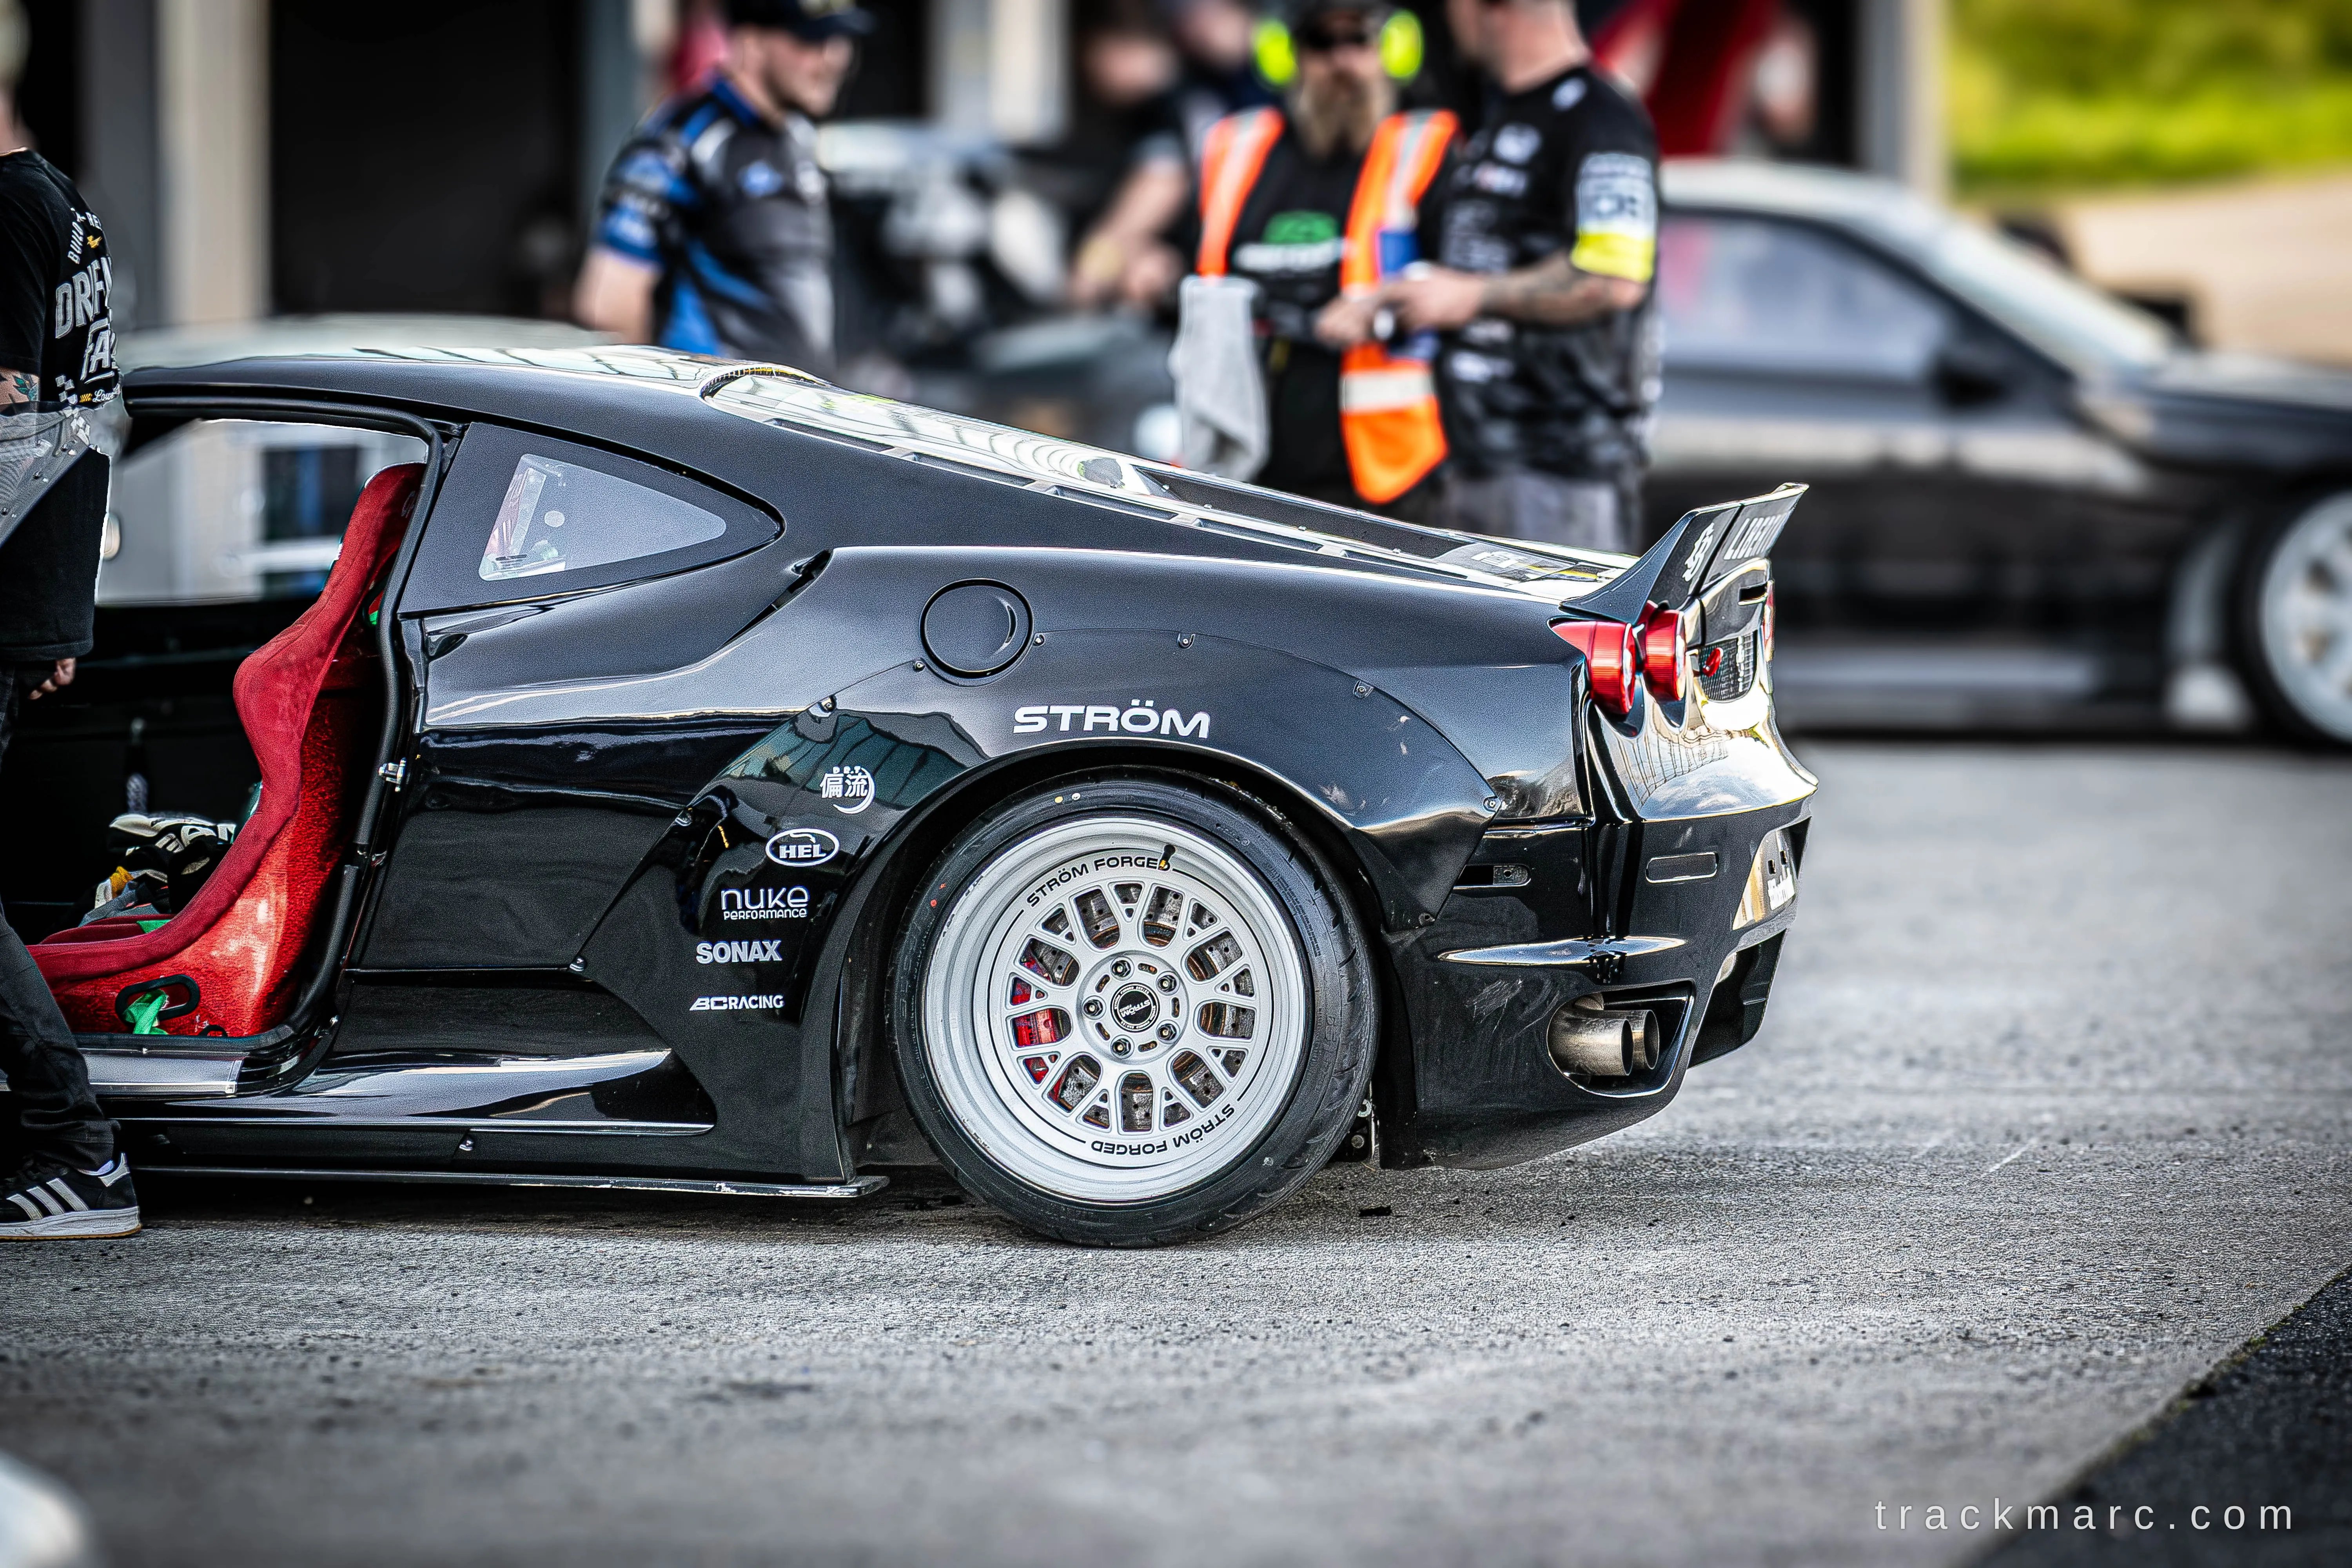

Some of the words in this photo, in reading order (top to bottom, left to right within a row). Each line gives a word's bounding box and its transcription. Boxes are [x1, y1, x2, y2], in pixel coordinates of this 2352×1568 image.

[1013, 699, 1210, 739] STRÖM
[820, 772, 867, 798] 偏流
[779, 843, 827, 858] HEL
[1027, 864, 1089, 907] STRÖM
[696, 940, 783, 964] SONAX
[1121, 1000, 1151, 1017] STRÖM
[1172, 1103, 1235, 1148] STRÖM
[1091, 1140, 1168, 1155] FORGED
